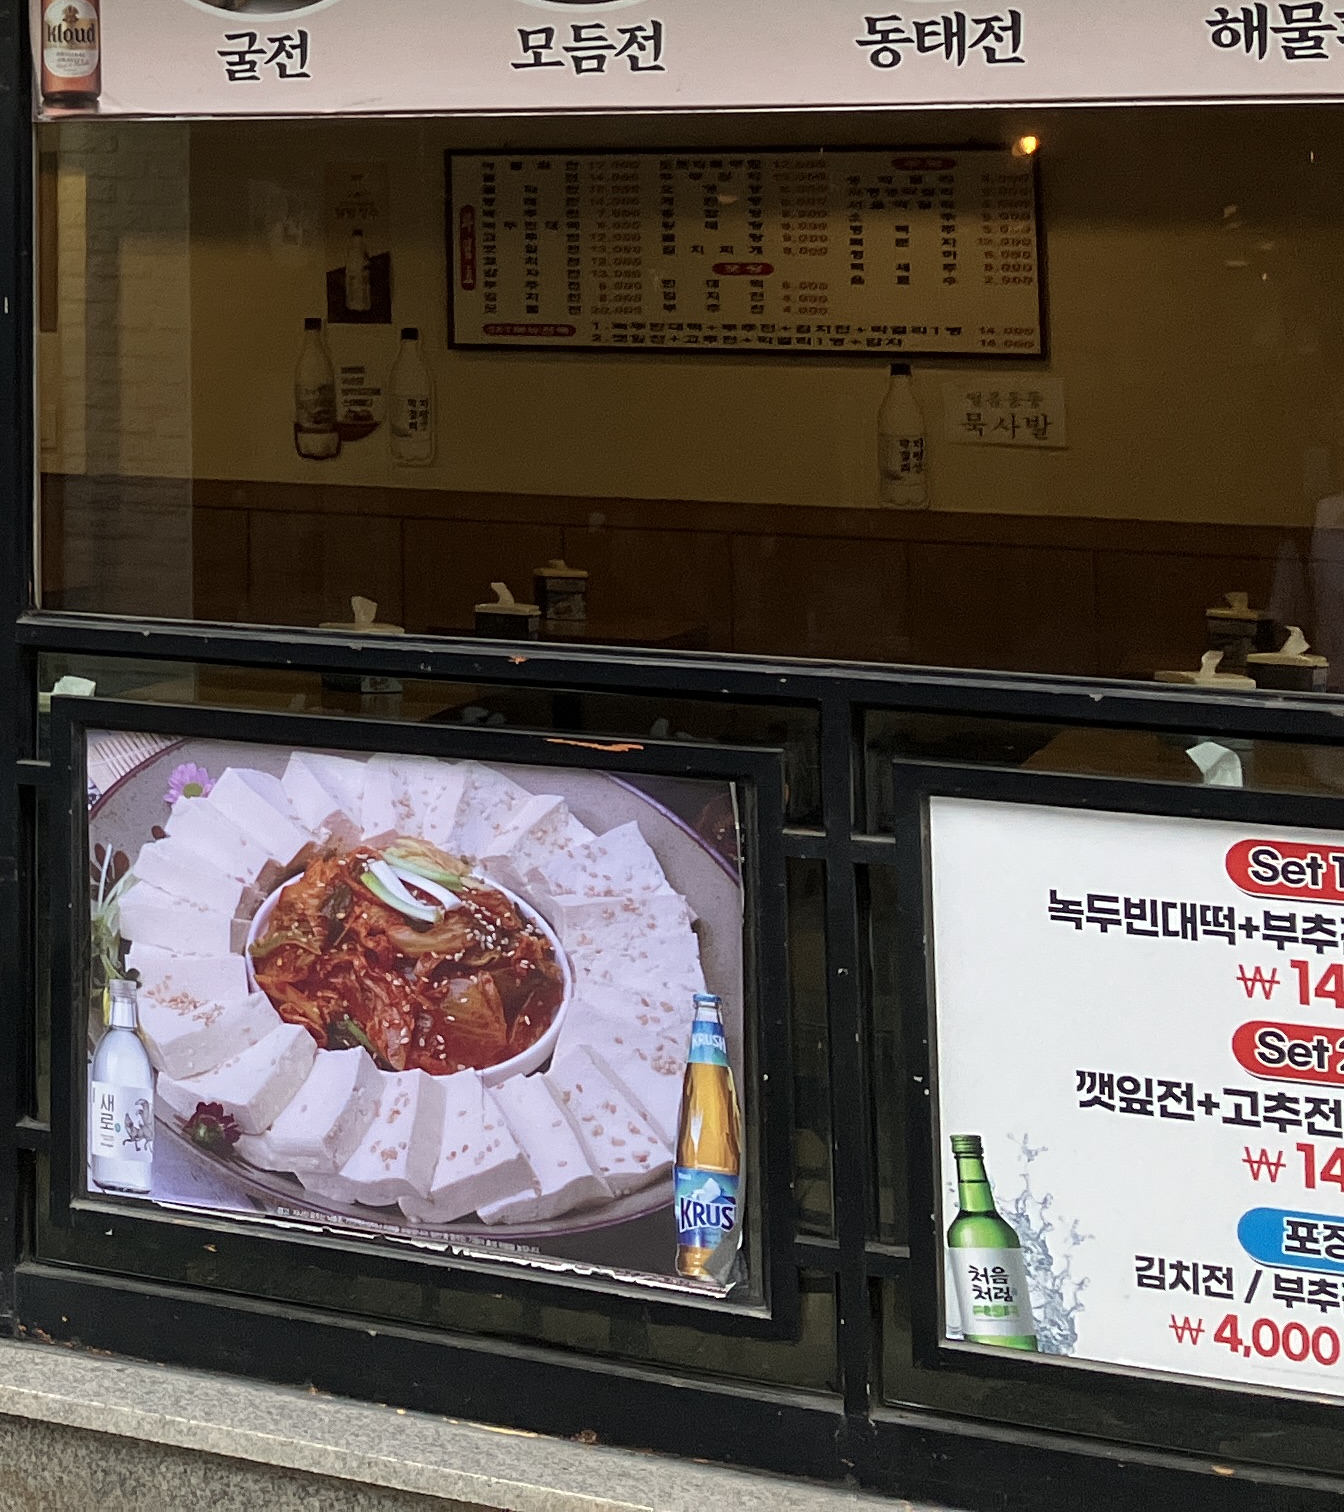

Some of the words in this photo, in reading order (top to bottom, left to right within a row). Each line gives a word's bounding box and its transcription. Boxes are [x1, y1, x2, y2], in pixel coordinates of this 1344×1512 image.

[47, 23, 95, 43] Kloud
[511, 19, 666, 75] 모듬전
[855, 9, 1027, 69] 동태전
[1206, 0, 1344, 61] 해물
[217, 28, 313, 83] 굴전
[959, 413, 1053, 442] 묵사발
[1048, 888, 1344, 955] 녹두빈대떡+부추
[1256, 1030, 1344, 1070] Set
[100, 1093, 115, 1131] 새로
[679, 1197, 735, 1232] KRUS
[969, 1265, 1009, 1284] 처음
[973, 1285, 1013, 1303] 처럼
[1135, 1255, 1233, 1300] 김치전
[1273, 1274, 1344, 1313] 부추
